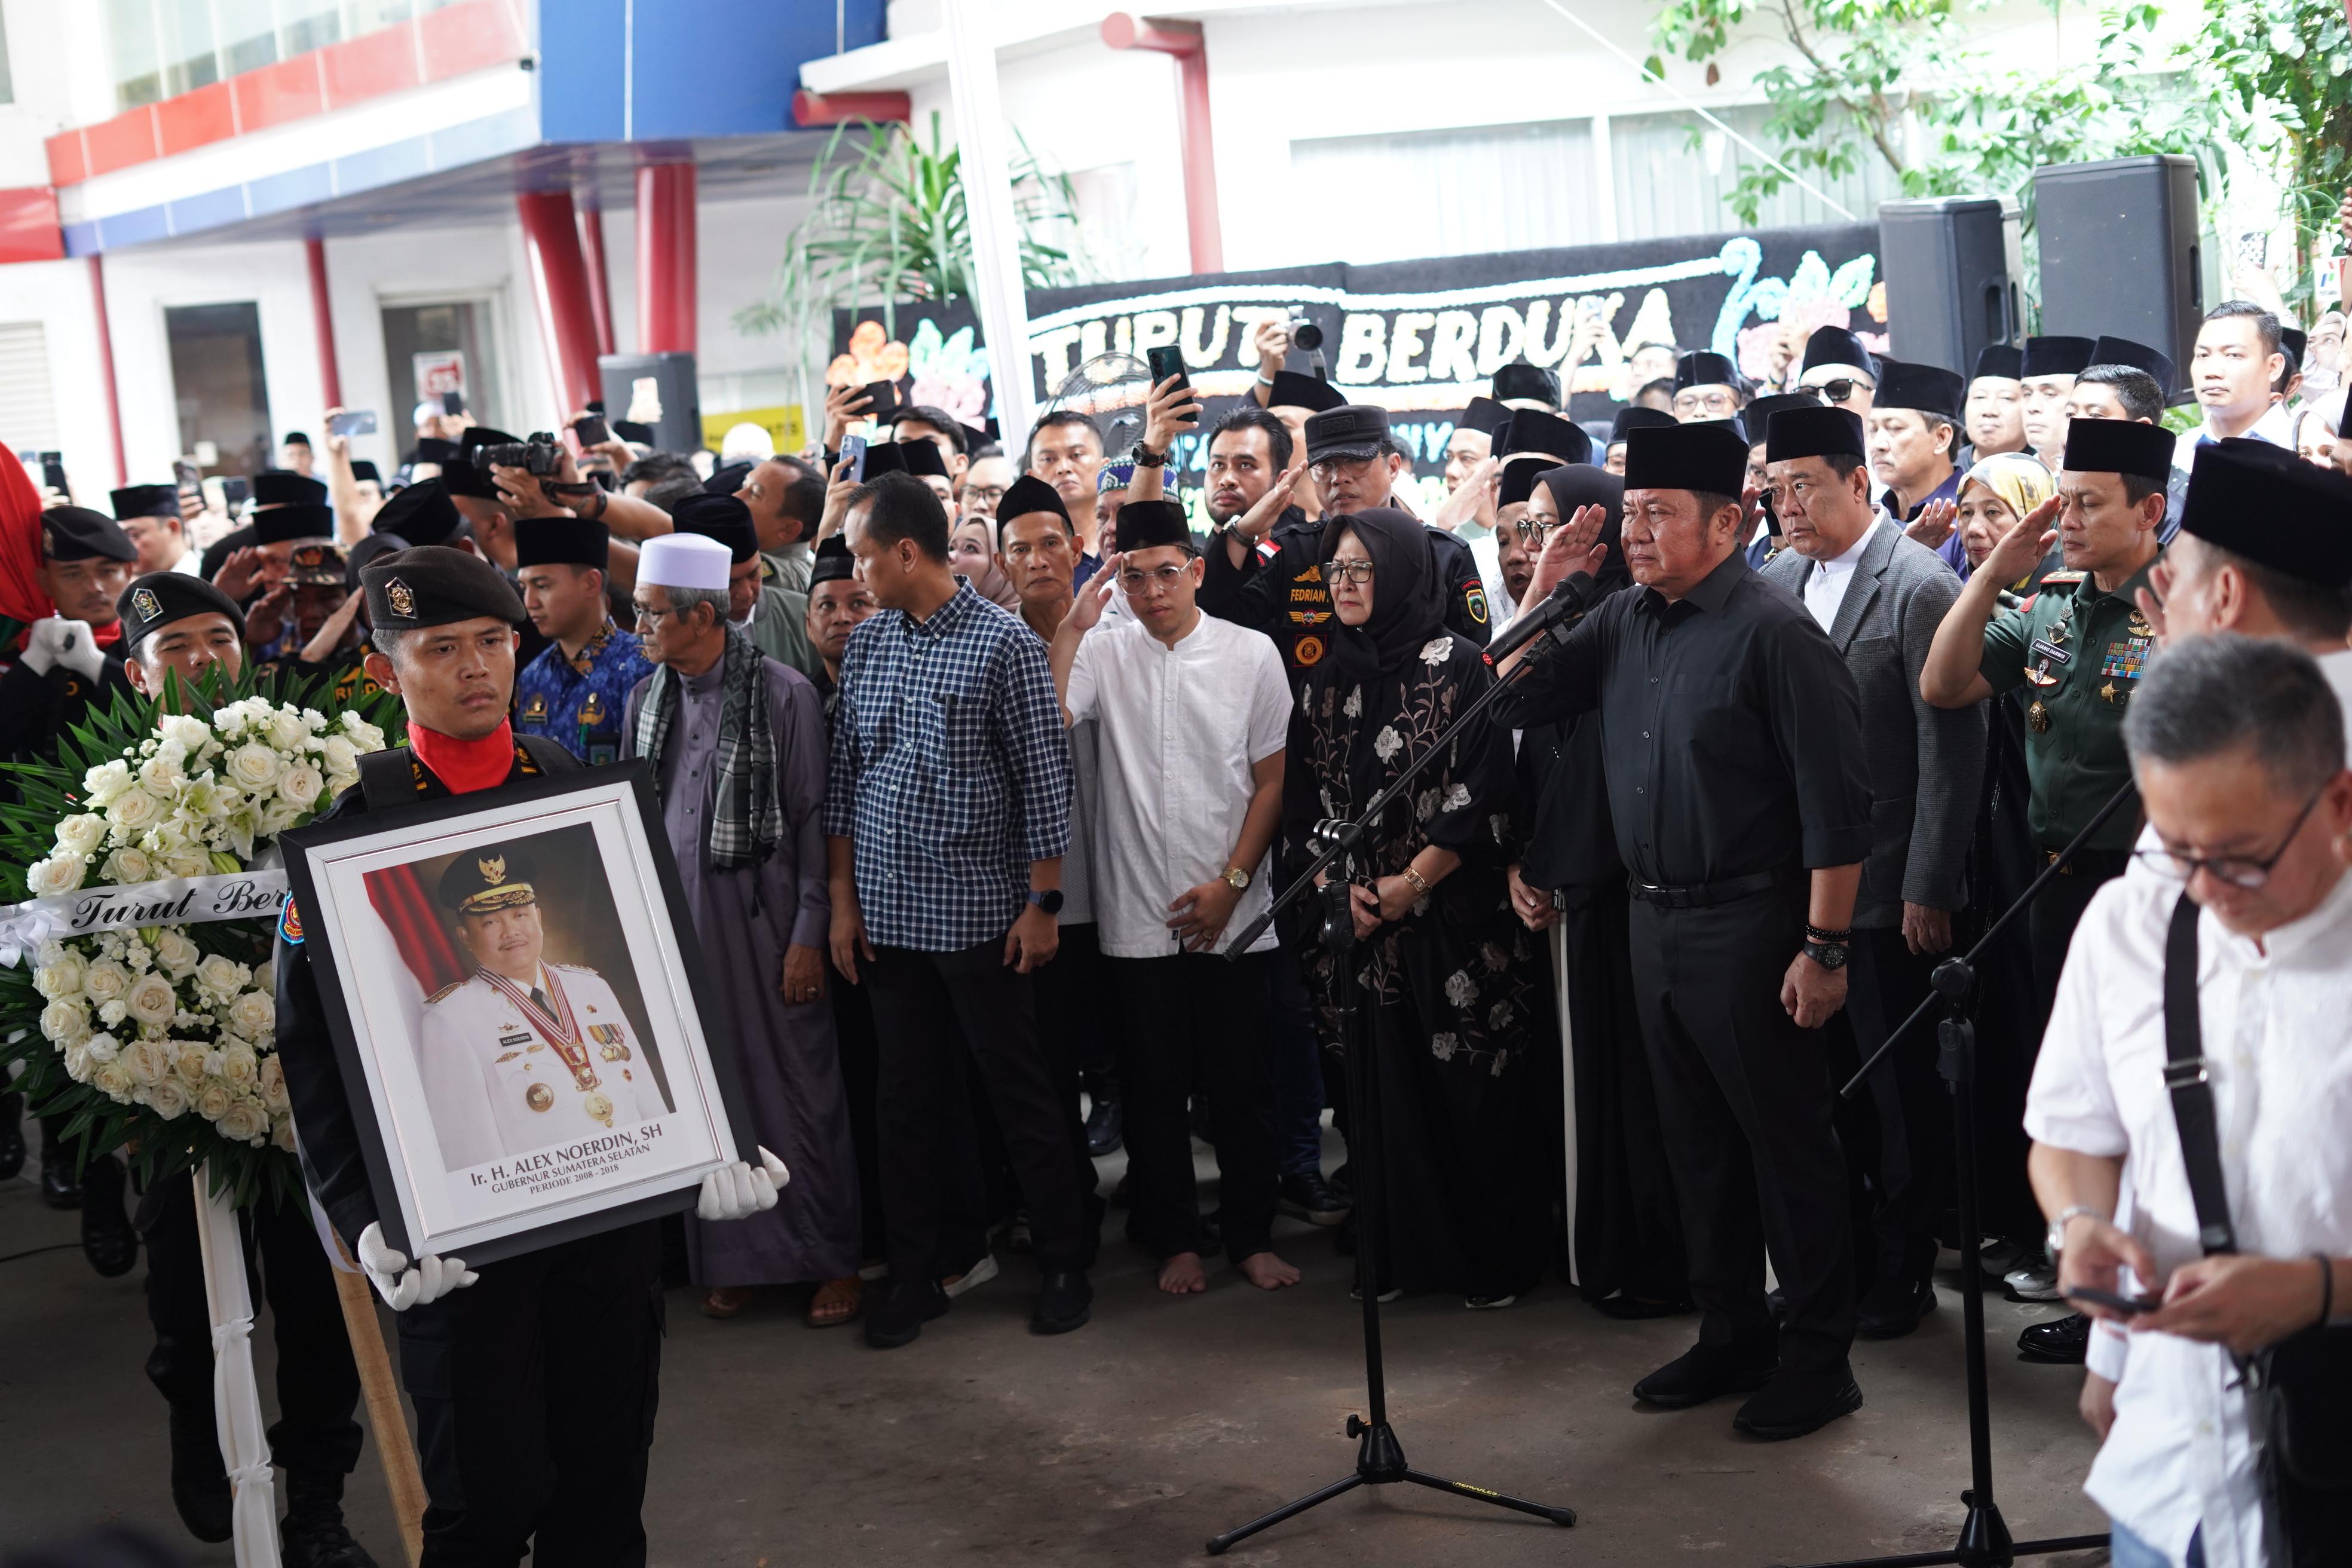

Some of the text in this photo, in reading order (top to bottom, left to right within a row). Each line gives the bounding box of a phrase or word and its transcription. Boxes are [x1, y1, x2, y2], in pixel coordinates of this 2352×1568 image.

[1336, 287, 1677, 384] BERDUKA
[1290, 589, 1326, 603] FEDRIAN
[2035, 642, 2066, 659] UJANG DARWIS
[71, 888, 197, 929] Turut
[470, 1123, 663, 1186] Ir. H. ALEX NOERDIN, SH
[492, 1143, 650, 1194] GUBERNUR SUMATERA SELATAN
[530, 1177, 573, 1195] PERIODE
[574, 1171, 594, 1184] 2008
[601, 1163, 619, 1177] 2018
